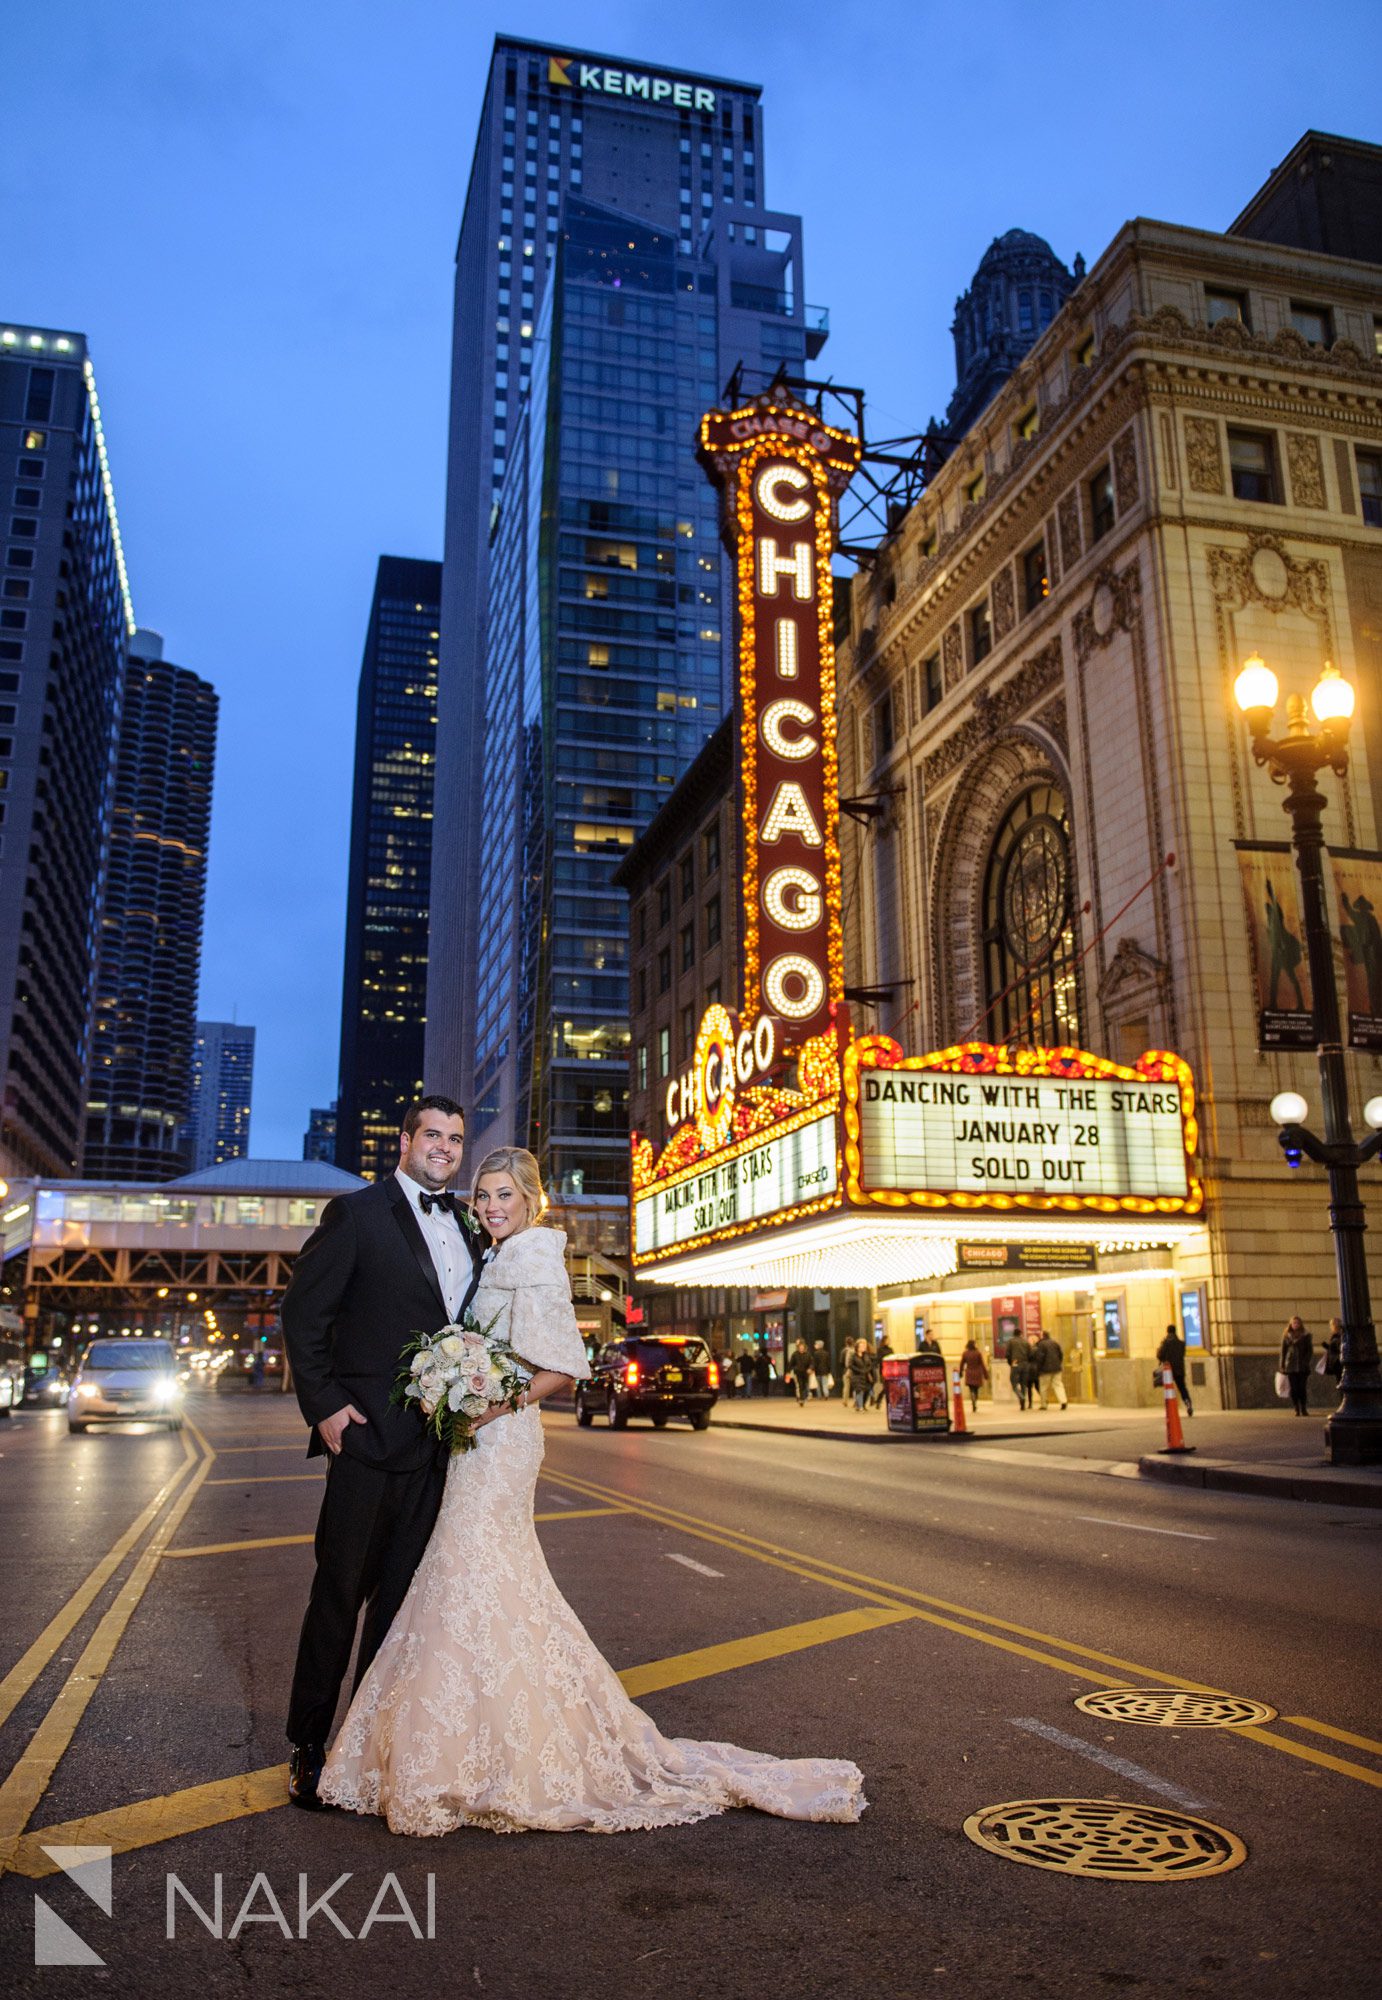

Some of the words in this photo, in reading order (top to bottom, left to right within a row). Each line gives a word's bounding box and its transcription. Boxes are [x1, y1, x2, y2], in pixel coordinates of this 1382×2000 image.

[579, 64, 716, 112] KEMPER
[731, 415, 808, 440] CHASE
[754, 463, 827, 1021] CHICAGO
[666, 1014, 775, 1127] CHICAGO
[865, 1079, 970, 1105] DANCING
[981, 1084, 1039, 1108] WITH
[1055, 1088, 1097, 1110] THE
[1111, 1091, 1179, 1114] STARS
[956, 1120, 1060, 1145] JANUARY
[1074, 1124, 1100, 1146] 28
[665, 1182, 694, 1214] DANCING
[698, 1171, 717, 1201] WITH
[721, 1162, 738, 1195] THE
[742, 1147, 773, 1184] STARS
[798, 1173, 821, 1189] CHASE
[972, 1157, 1030, 1180] SOLD
[1043, 1160, 1086, 1182] OUT
[694, 1203, 714, 1232] SOLD
[720, 1194, 737, 1222] OUT
[967, 1249, 1003, 1257] CHICAGO
